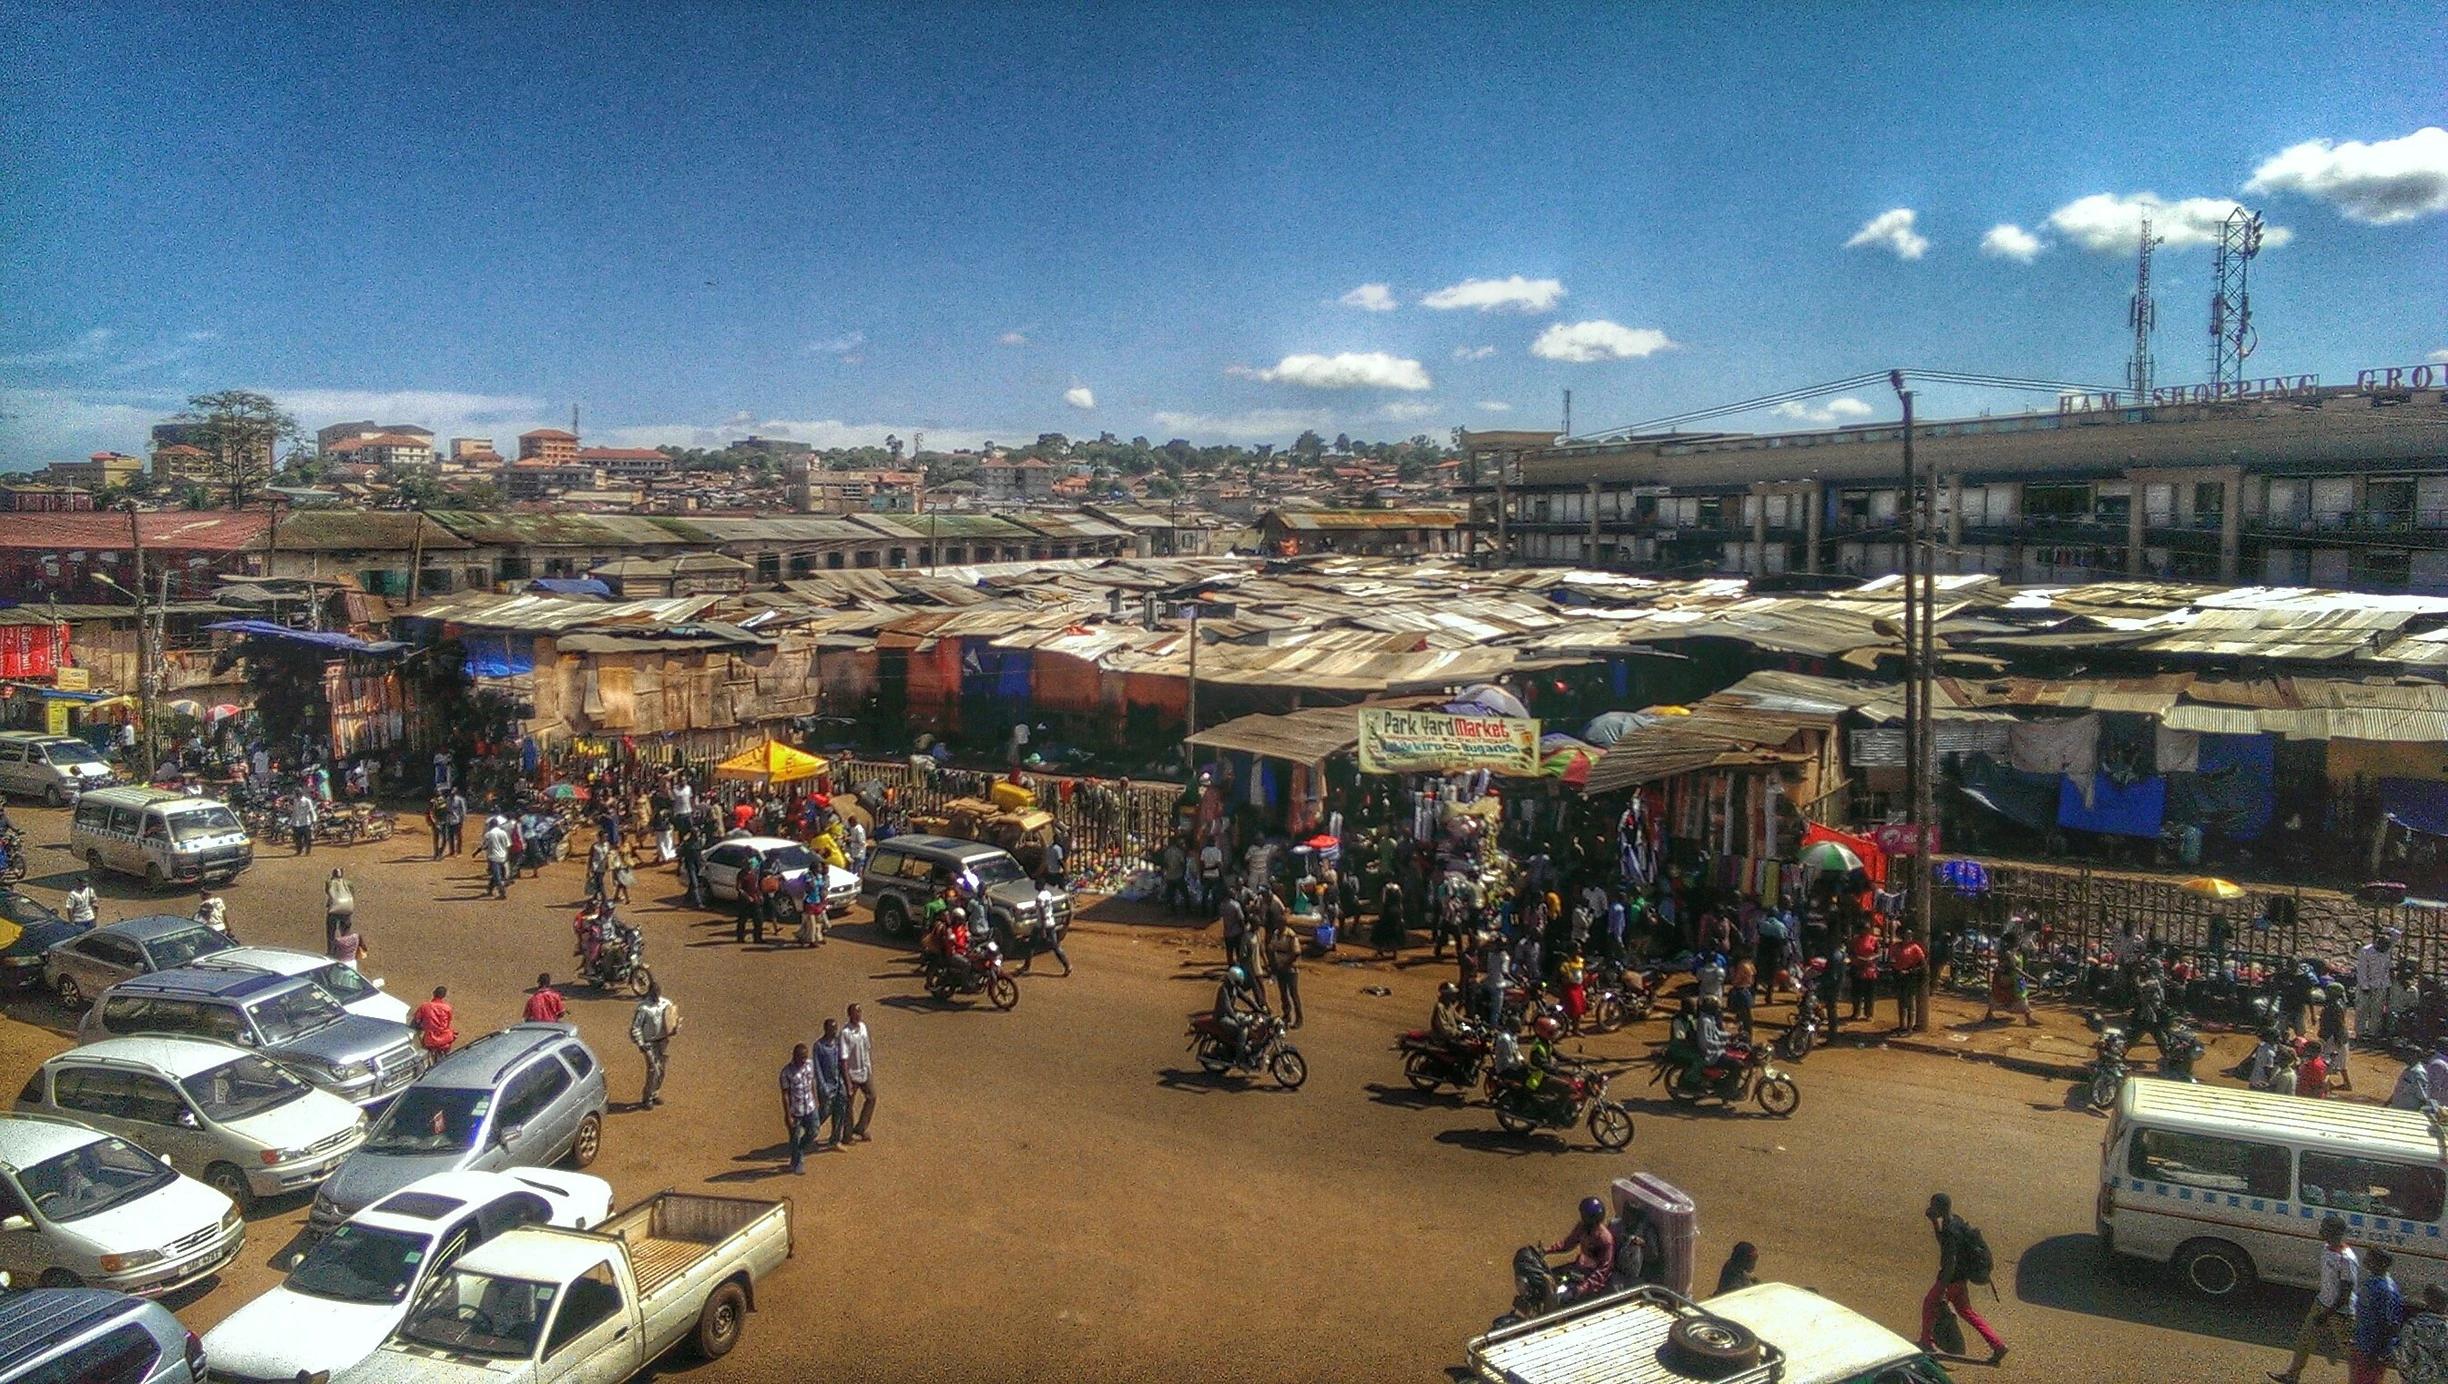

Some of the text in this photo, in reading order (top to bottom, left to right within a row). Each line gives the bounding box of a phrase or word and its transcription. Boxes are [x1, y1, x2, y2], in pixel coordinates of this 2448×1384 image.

[2060, 363, 2448, 414] HAM SHOPPING GRO
[1384, 711, 1417, 734] Park
[1421, 715, 1455, 736] Yard
[1455, 718, 1510, 738] Market
